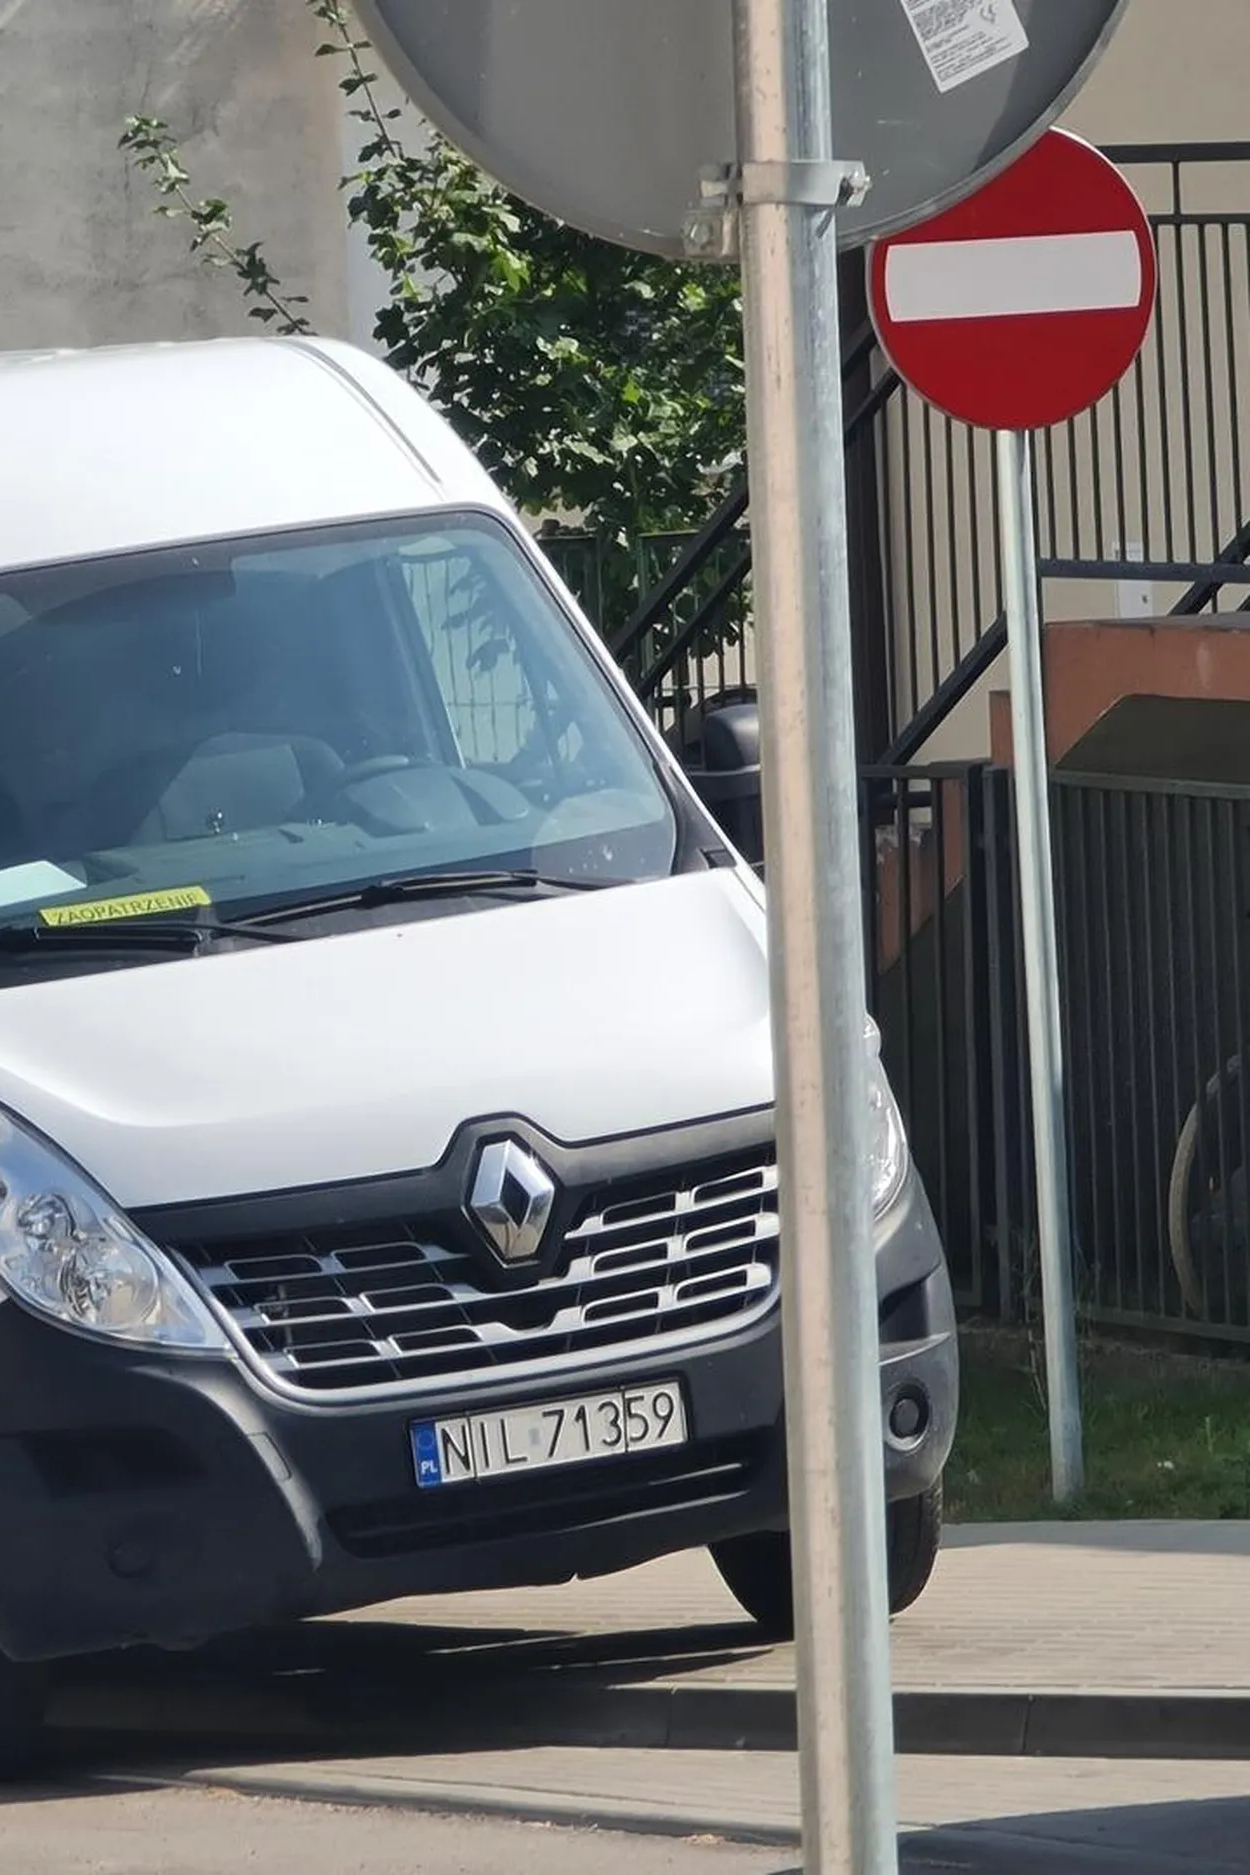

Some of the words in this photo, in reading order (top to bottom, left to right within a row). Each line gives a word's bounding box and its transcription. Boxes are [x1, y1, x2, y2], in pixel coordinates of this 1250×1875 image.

[51, 893, 197, 925] ZAOPATRZENIE
[440, 1418, 528, 1475] NIL
[541, 1391, 675, 1458] 71359
[420, 1461, 438, 1475] PL
